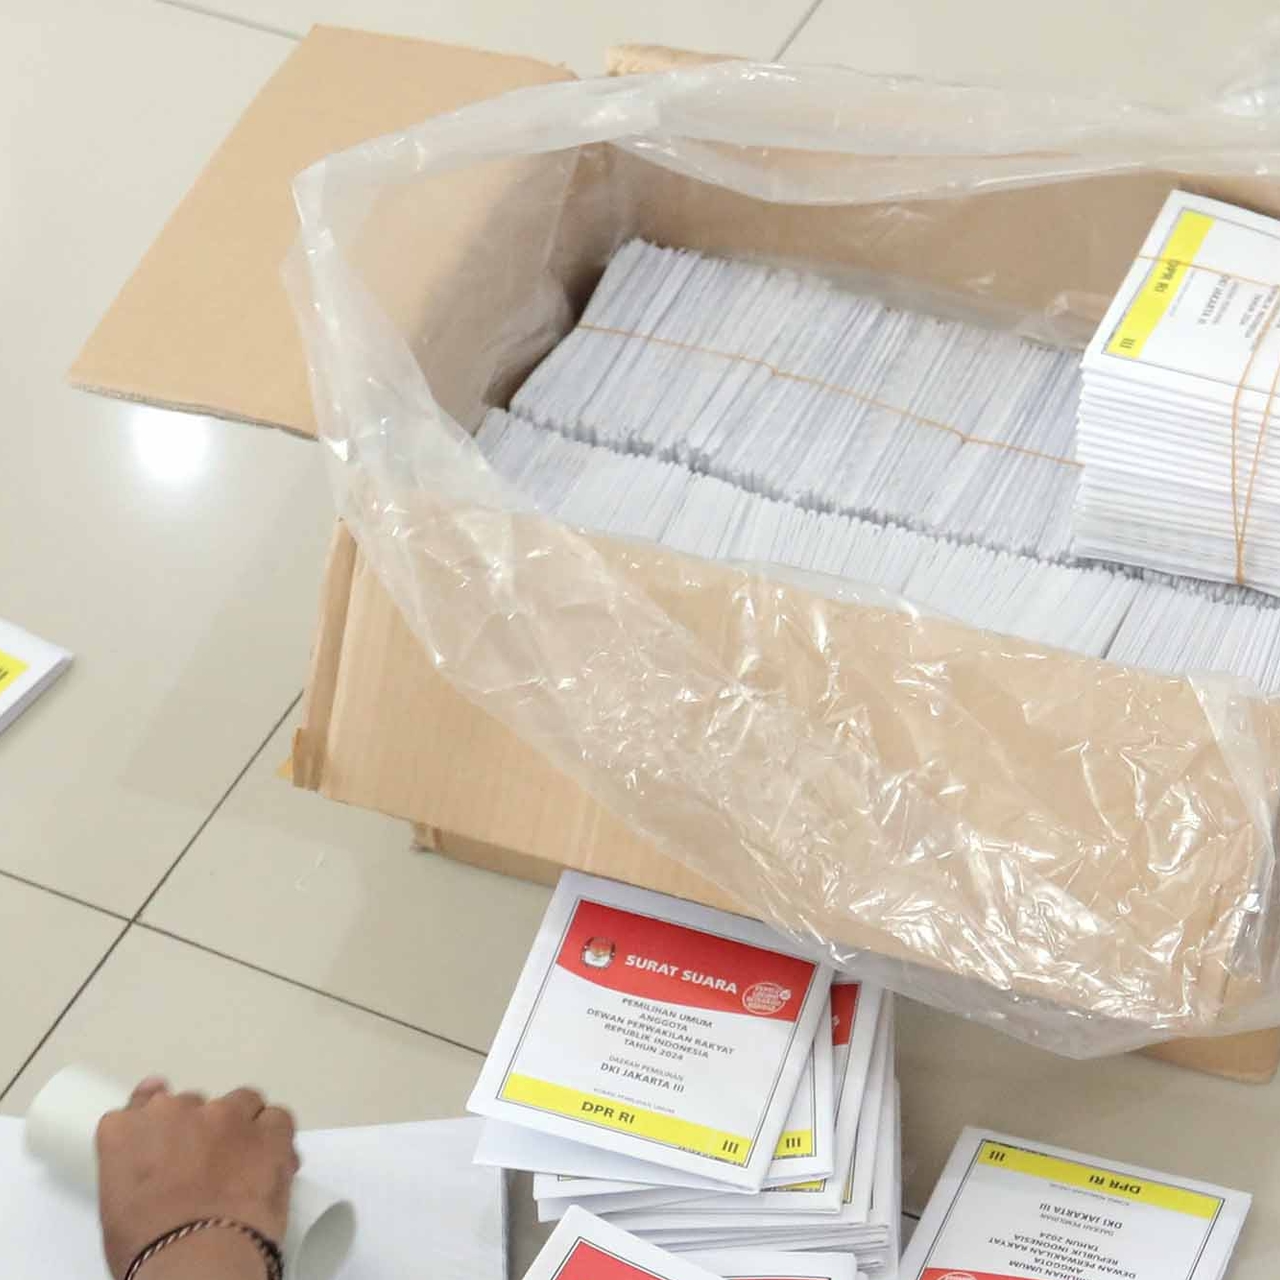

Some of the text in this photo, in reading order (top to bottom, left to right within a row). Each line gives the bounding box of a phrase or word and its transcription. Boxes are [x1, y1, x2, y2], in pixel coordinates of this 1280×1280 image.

[1119, 338, 1136, 349] III
[624, 954, 738, 995] SURAT SUARA
[622, 998, 713, 1029] PEMILIHAN UMUM
[638, 1012, 689, 1032] ANGGOTA
[586, 1007, 736, 1056] DEWAN PERWAKILAN RAKYAT
[604, 1022, 709, 1059] REPUBLIK INDONESIA
[624, 1038, 684, 1062] TAHUN 2024
[600, 1062, 685, 1093] DKI JAKARTA III
[581, 1101, 615, 1119] DPR
[618, 1110, 636, 1125] RI
[722, 1139, 740, 1155] III
[786, 1137, 801, 1149] III
[989, 1150, 1006, 1162] III
[1089, 1174, 1106, 1186] RI
[1109, 1180, 1142, 1195] DPR
[1039, 1202, 1124, 1230] DKI JAKARTA III
[1013, 1233, 1119, 1266] REPUBLIK INDONESIA
[1039, 1231, 1100, 1252] TAHUN 2024
[987, 1236, 1137, 1280] DEWAN PERWAKILAN RAKYAT
[1008, 1259, 1044, 1273] UMUM
[1033, 1256, 1084, 1275] ANGGOTA
